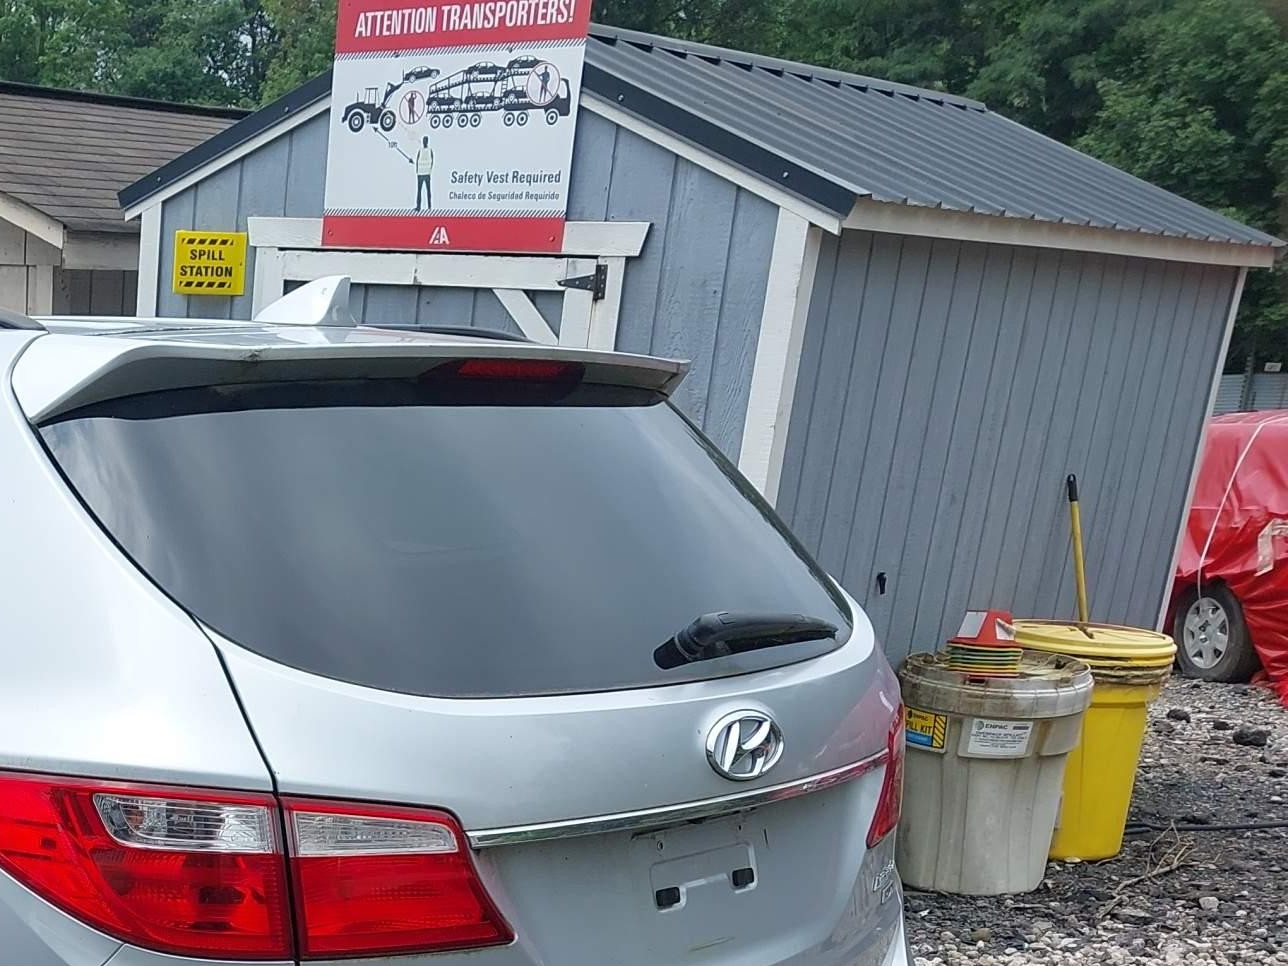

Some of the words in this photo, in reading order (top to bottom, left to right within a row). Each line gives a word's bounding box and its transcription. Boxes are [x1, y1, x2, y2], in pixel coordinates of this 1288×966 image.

[355, 7, 436, 37] ATTENTION
[441, 0, 575, 32] TRANSPORTERS!
[450, 171, 483, 186] Safety
[486, 171, 509, 184] Vest
[511, 170, 562, 187] Required
[449, 191, 476, 200] Chaleco
[477, 191, 486, 200] de
[487, 191, 524, 202] Seguridad
[524, 192, 560, 202] Requirido
[189, 249, 225, 261] SPILL
[179, 265, 233, 277] STATION
[920, 725, 932, 735] KIT
